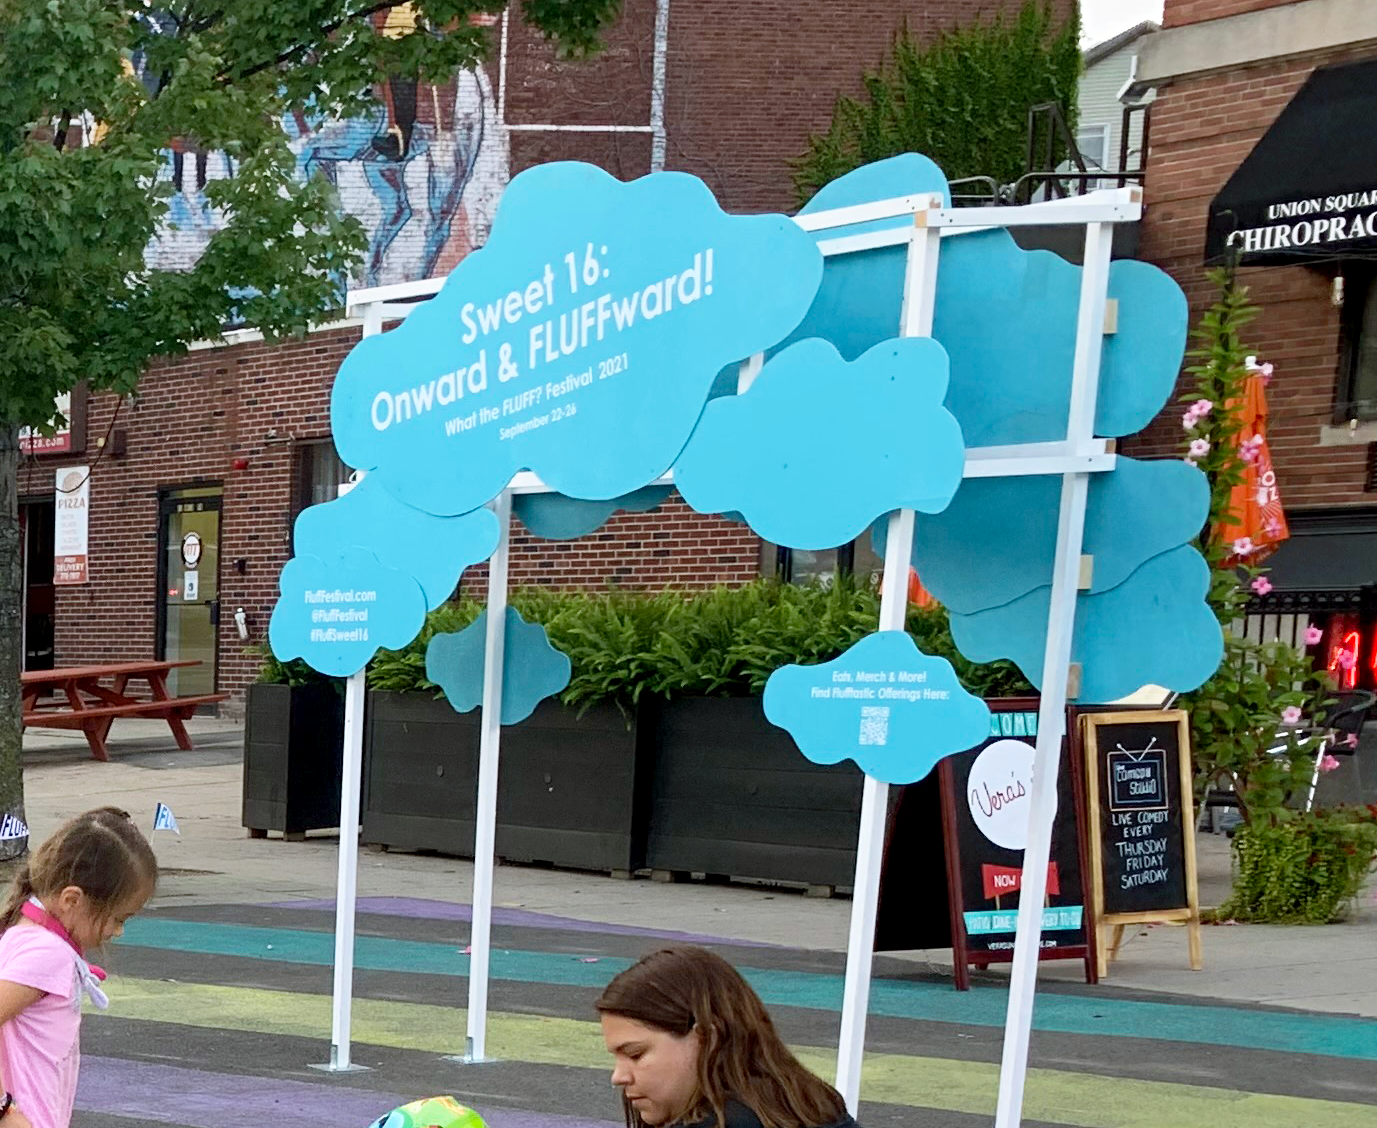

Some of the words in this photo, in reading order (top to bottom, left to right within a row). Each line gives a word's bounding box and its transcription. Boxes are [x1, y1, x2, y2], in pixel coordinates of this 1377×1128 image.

[1269, 198, 1322, 219] UNION
[461, 263, 554, 344] Sweet
[563, 242, 610, 294] 16:
[371, 350, 487, 431] Onward
[498, 343, 519, 383] &
[529, 248, 714, 369] FLUFFward!
[445, 411, 477, 436] What
[479, 405, 499, 428] the
[503, 386, 542, 420] FLUFF?
[546, 367, 593, 401] Festival
[599, 353, 629, 379] 2021
[499, 414, 549, 440] September
[551, 403, 577, 423] 22-26
[58, 497, 86, 510] PIZZA
[832, 671, 853, 683] Eats,
[855, 671, 886, 682] Merch
[888, 671, 895, 682] &
[898, 671, 927, 683] More!
[811, 687, 830, 699] Find
[878, 687, 921, 702] Offerings
[924, 688, 951, 700] Here:
[971, 770, 1026, 817] Vera's
[1112, 812, 1132, 826] LIVE
[1137, 810, 1169, 824] COMEDY
[1123, 824, 1153, 838] EVERY
[1115, 837, 1168, 857] THURSDAY
[1126, 854, 1164, 871] FRIDAY
[994, 874, 1016, 888] NOW
[1121, 868, 1169, 889] SATURDAY
